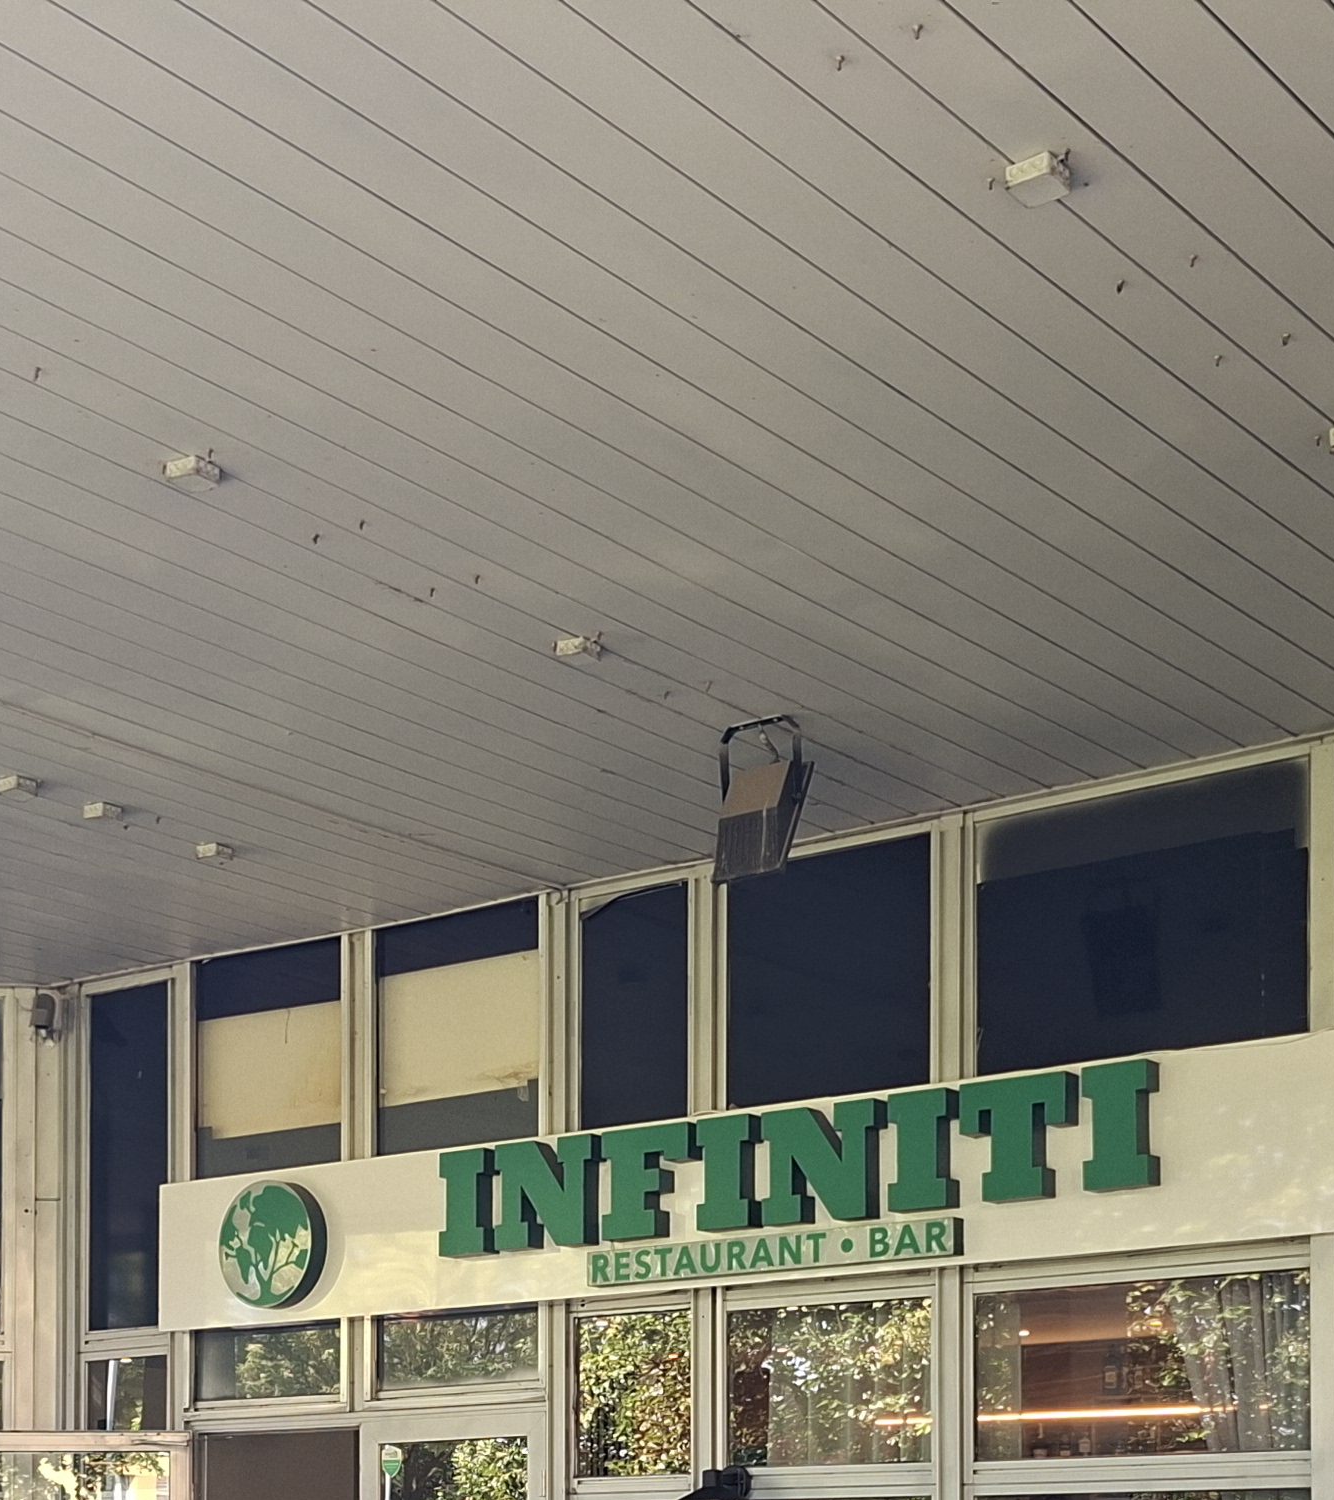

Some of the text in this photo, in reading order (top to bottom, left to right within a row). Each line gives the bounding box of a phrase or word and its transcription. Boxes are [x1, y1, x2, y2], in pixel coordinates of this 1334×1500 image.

[439, 1058, 1160, 1259] INFINITI
[590, 1220, 949, 1285] RESTAURANT BAR
